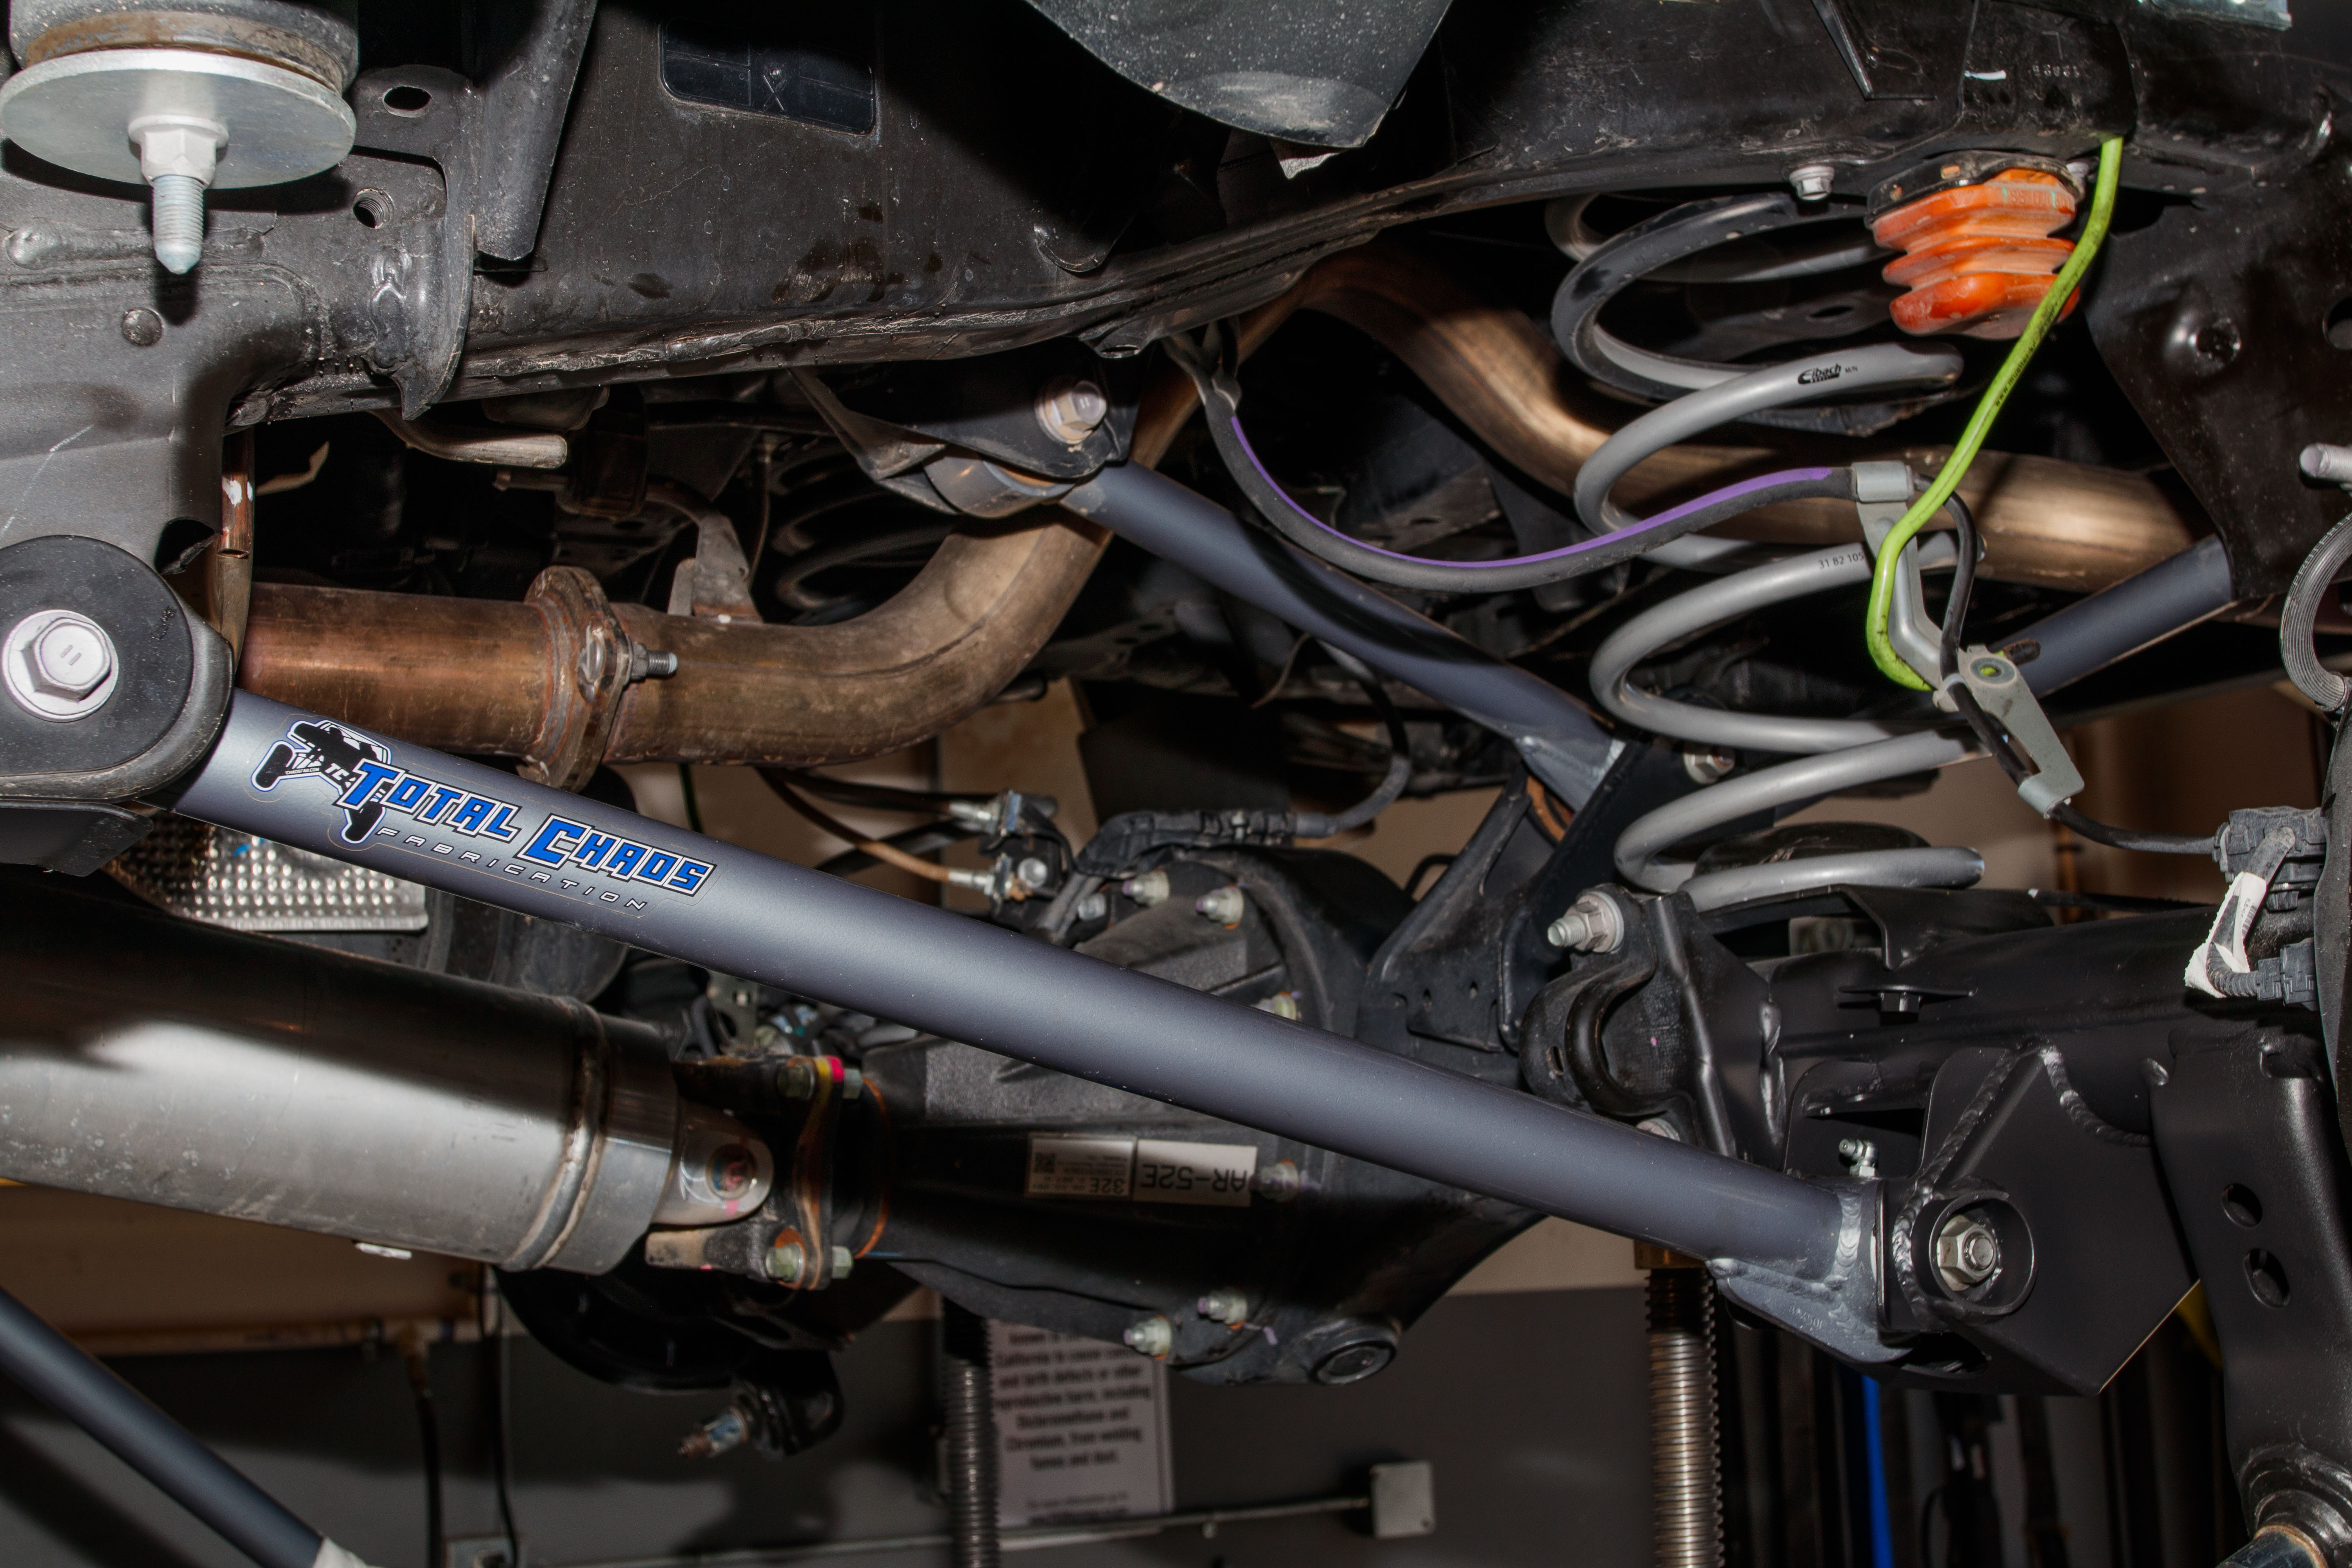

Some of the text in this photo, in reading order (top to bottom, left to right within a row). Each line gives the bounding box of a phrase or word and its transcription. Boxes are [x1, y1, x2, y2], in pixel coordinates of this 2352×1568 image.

[1798, 363, 1842, 385] Eibach
[1819, 559, 1829, 568] 31
[1847, 552, 1864, 563] 105
[325, 763, 349, 781] TC
[333, 759, 717, 897] TOTAL CHAOS
[377, 827, 645, 910] FABRICATION
[1140, 1163, 1248, 1192] AR-52E
